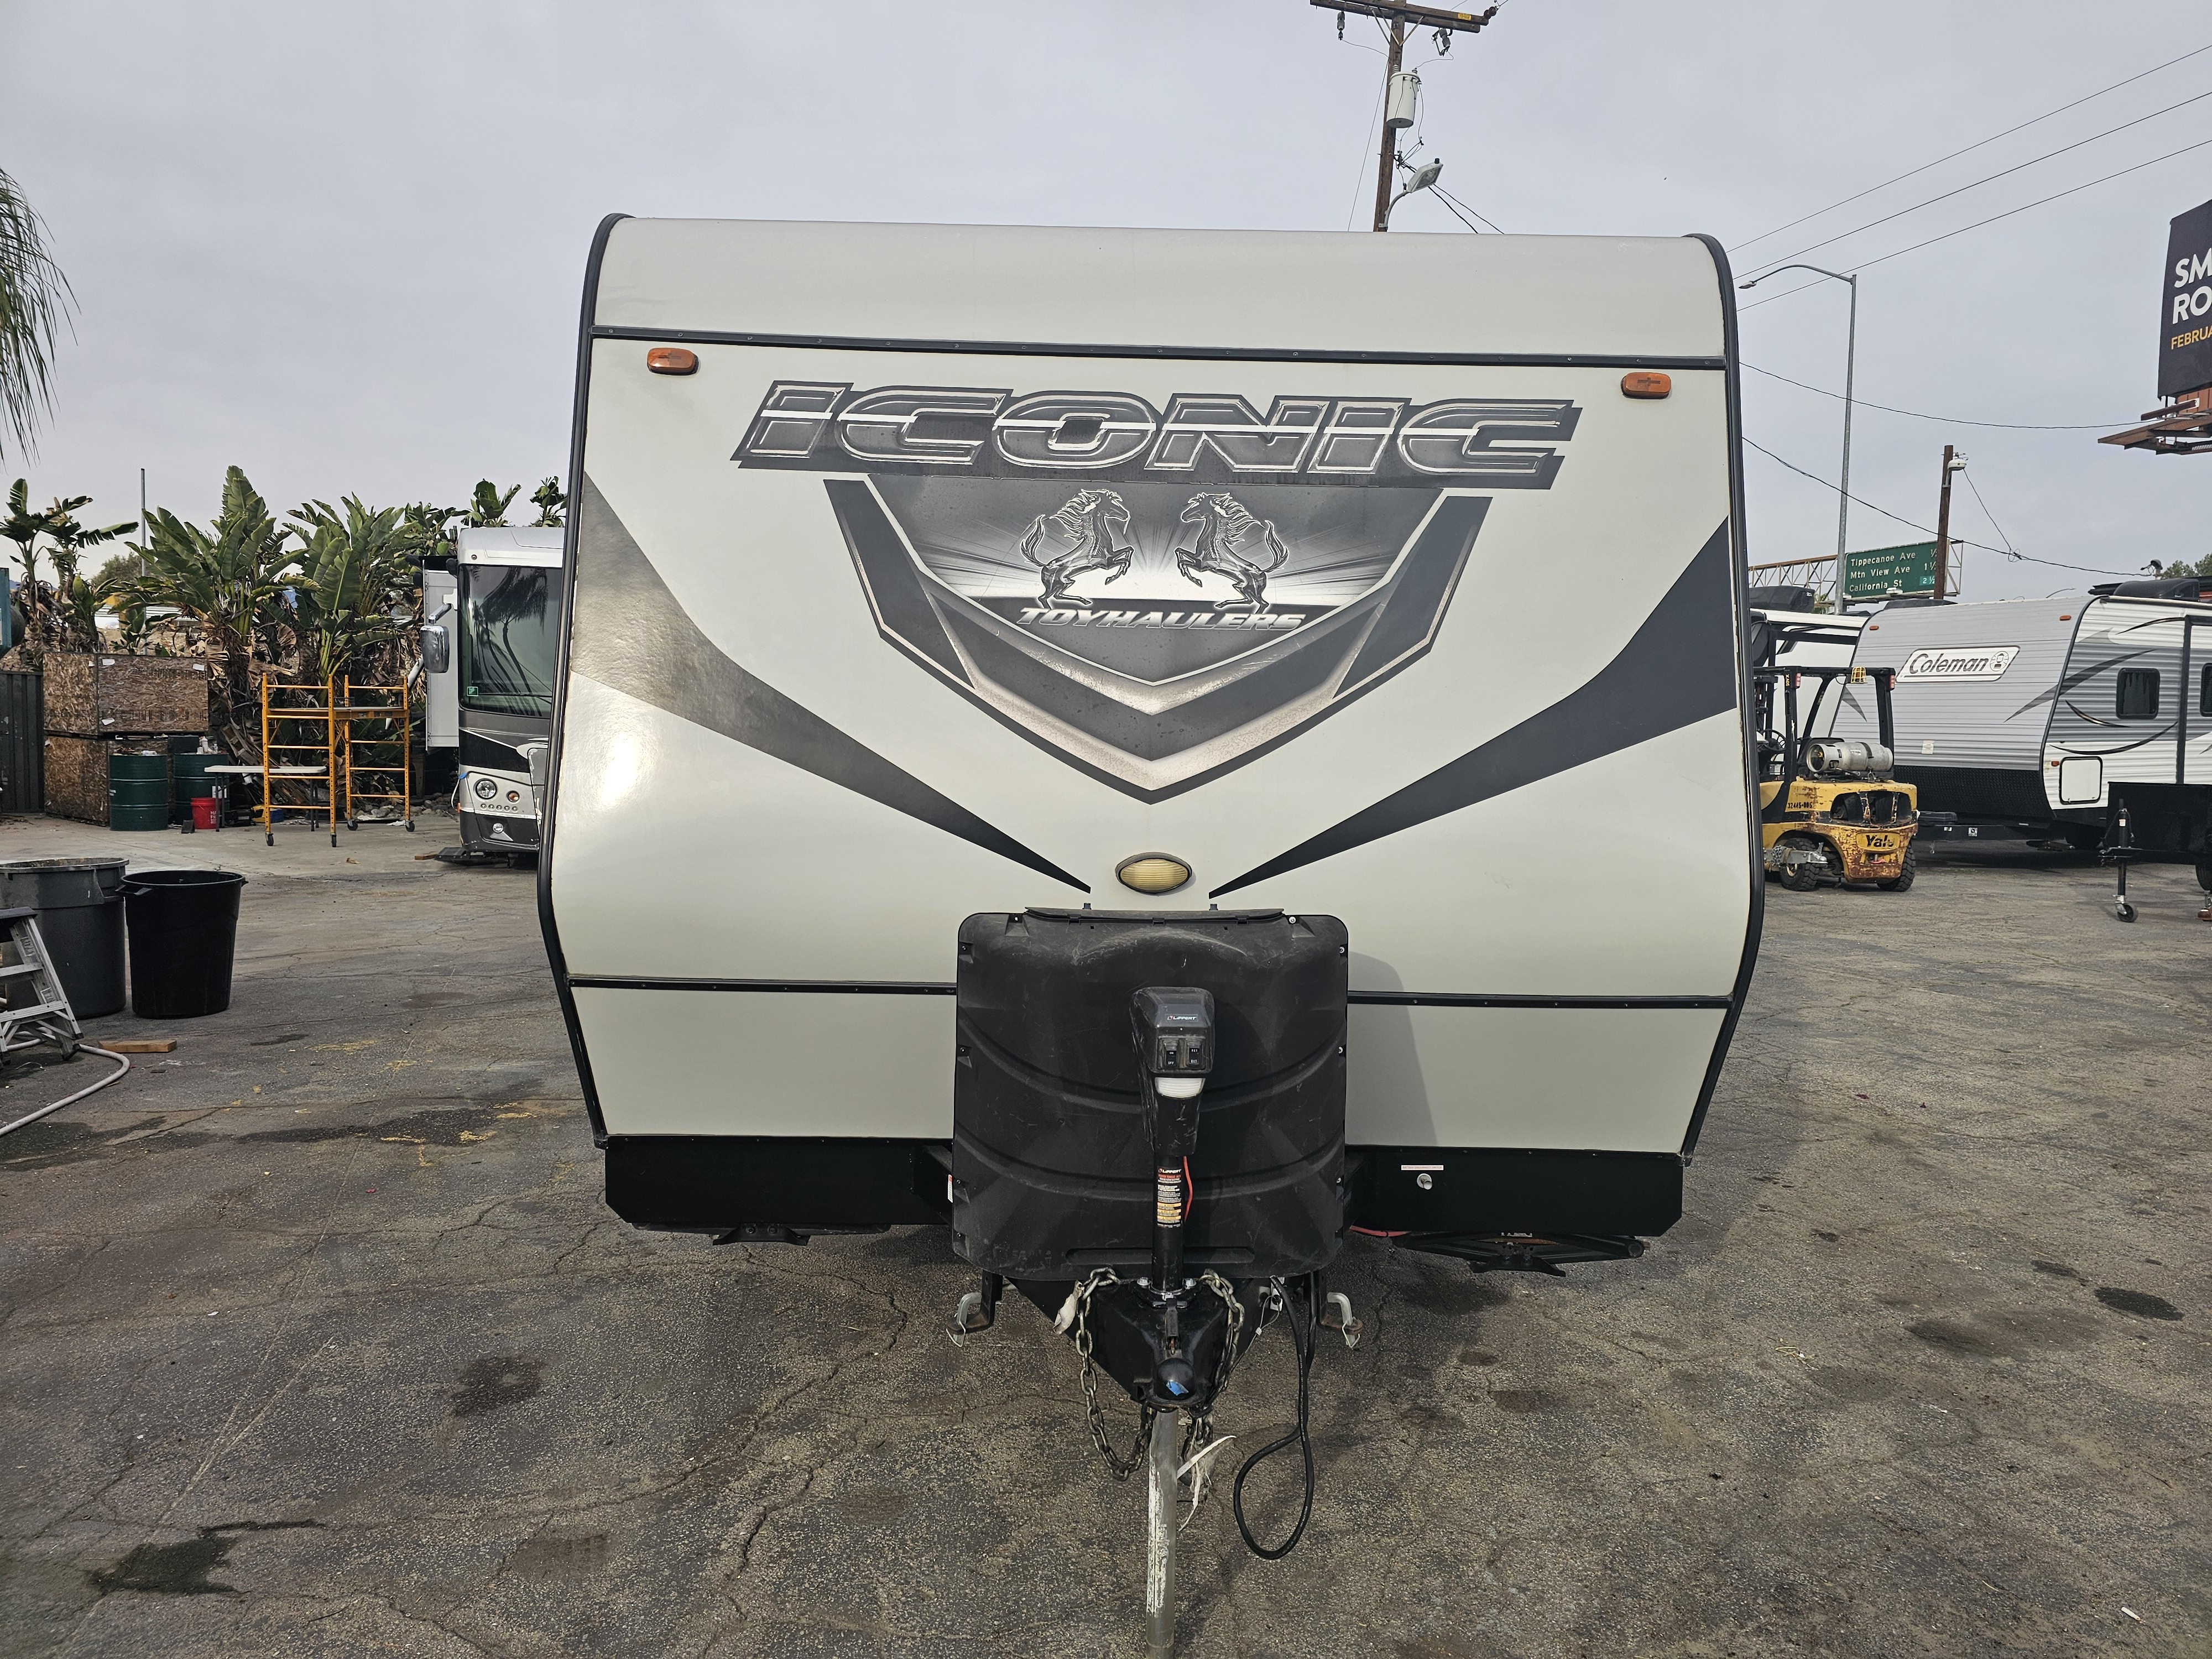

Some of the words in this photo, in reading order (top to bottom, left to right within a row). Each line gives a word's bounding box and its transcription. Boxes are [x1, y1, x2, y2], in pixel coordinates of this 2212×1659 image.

[1851, 555, 1895, 566] Tippecanoe
[1871, 568, 1889, 577] View
[1849, 581, 1887, 592] California
[1016, 608, 1307, 631] TOYHAULERS
[1910, 653, 1989, 674] Coleman
